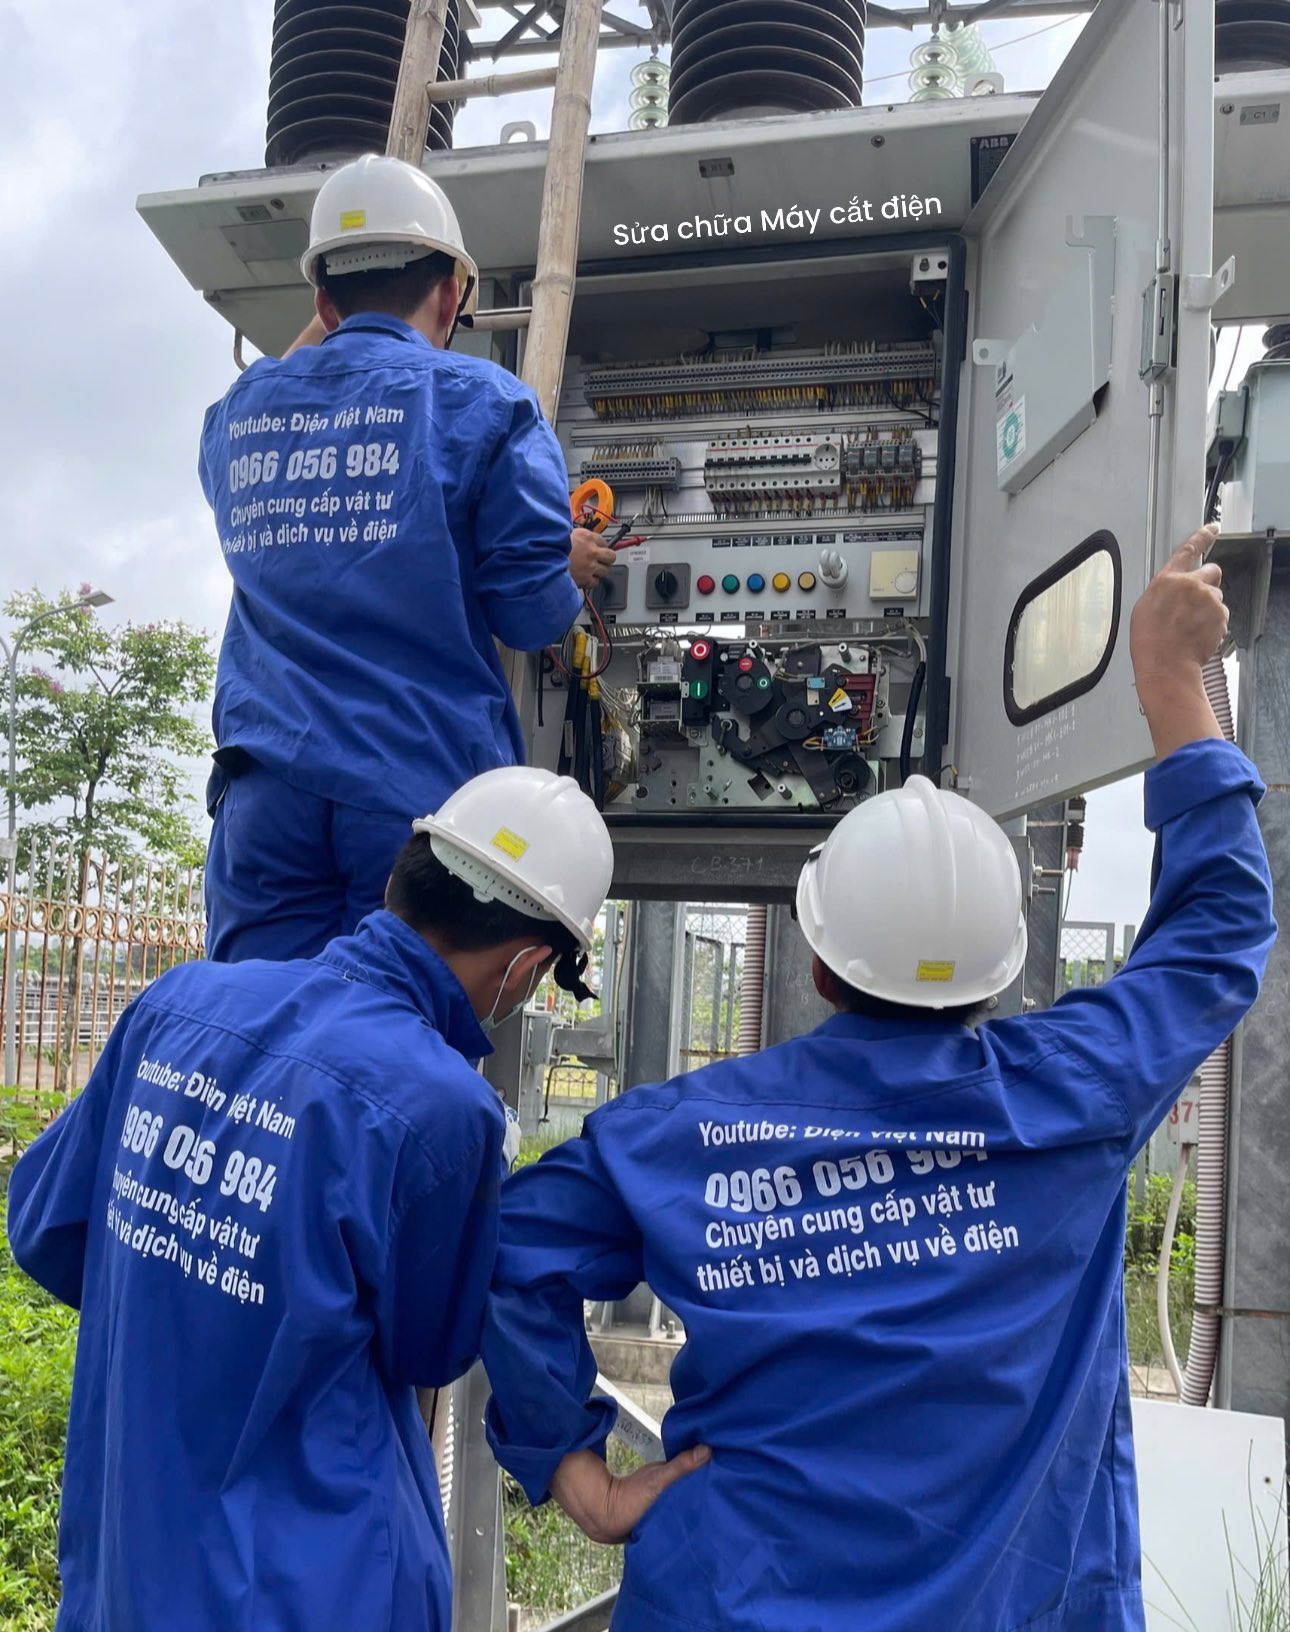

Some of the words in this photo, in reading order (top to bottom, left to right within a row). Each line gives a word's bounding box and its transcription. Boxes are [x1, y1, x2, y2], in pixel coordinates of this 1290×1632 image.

[979, 136, 1009, 150] ABB
[229, 413, 286, 441] Youtube:
[290, 412, 329, 435] Điện
[334, 406, 361, 429] Việt
[365, 405, 404, 425] Nam
[229, 450, 280, 494] 0966
[286, 446, 337, 481] 056
[345, 442, 400, 478] 984
[230, 498, 265, 528] Chuyên
[267, 497, 306, 519] cung
[310, 487, 339, 517] cấp
[345, 491, 371, 513] vật
[375, 489, 393, 510] tư
[247, 529, 257, 553] bị
[259, 524, 273, 548] và
[276, 523, 308, 548] dịch
[314, 527, 334, 549] vụ
[339, 517, 358, 543] về
[363, 517, 398, 544] điện
[136, 1052, 186, 1093] outube:
[255, 1100, 296, 1140] Nam
[698, 1119, 797, 1148] Youtube:
[219, 1150, 278, 1214] 984
[703, 1165, 803, 1214] 0966
[812, 1148, 895, 1198] 056
[136, 1184, 179, 1225] cung
[179, 1197, 207, 1240] cấp
[209, 1215, 239, 1251] vật
[239, 1226, 261, 1260] tư
[704, 1213, 795, 1251] Chuyên
[801, 1207, 863, 1235] cung
[870, 1189, 917, 1227] cấp
[921, 1184, 963, 1223] vật
[967, 1180, 996, 1208] tư
[131, 1224, 179, 1263] dịch
[179, 1246, 193, 1279] vụ
[197, 1250, 219, 1286] về
[220, 1265, 265, 1305] điện
[696, 1253, 755, 1293] thiết
[760, 1257, 786, 1288] bị
[789, 1248, 820, 1281] và
[826, 1240, 882, 1280] dịch
[887, 1240, 919, 1268] vụ
[925, 1223, 957, 1258] về
[964, 1219, 1020, 1256] điện
